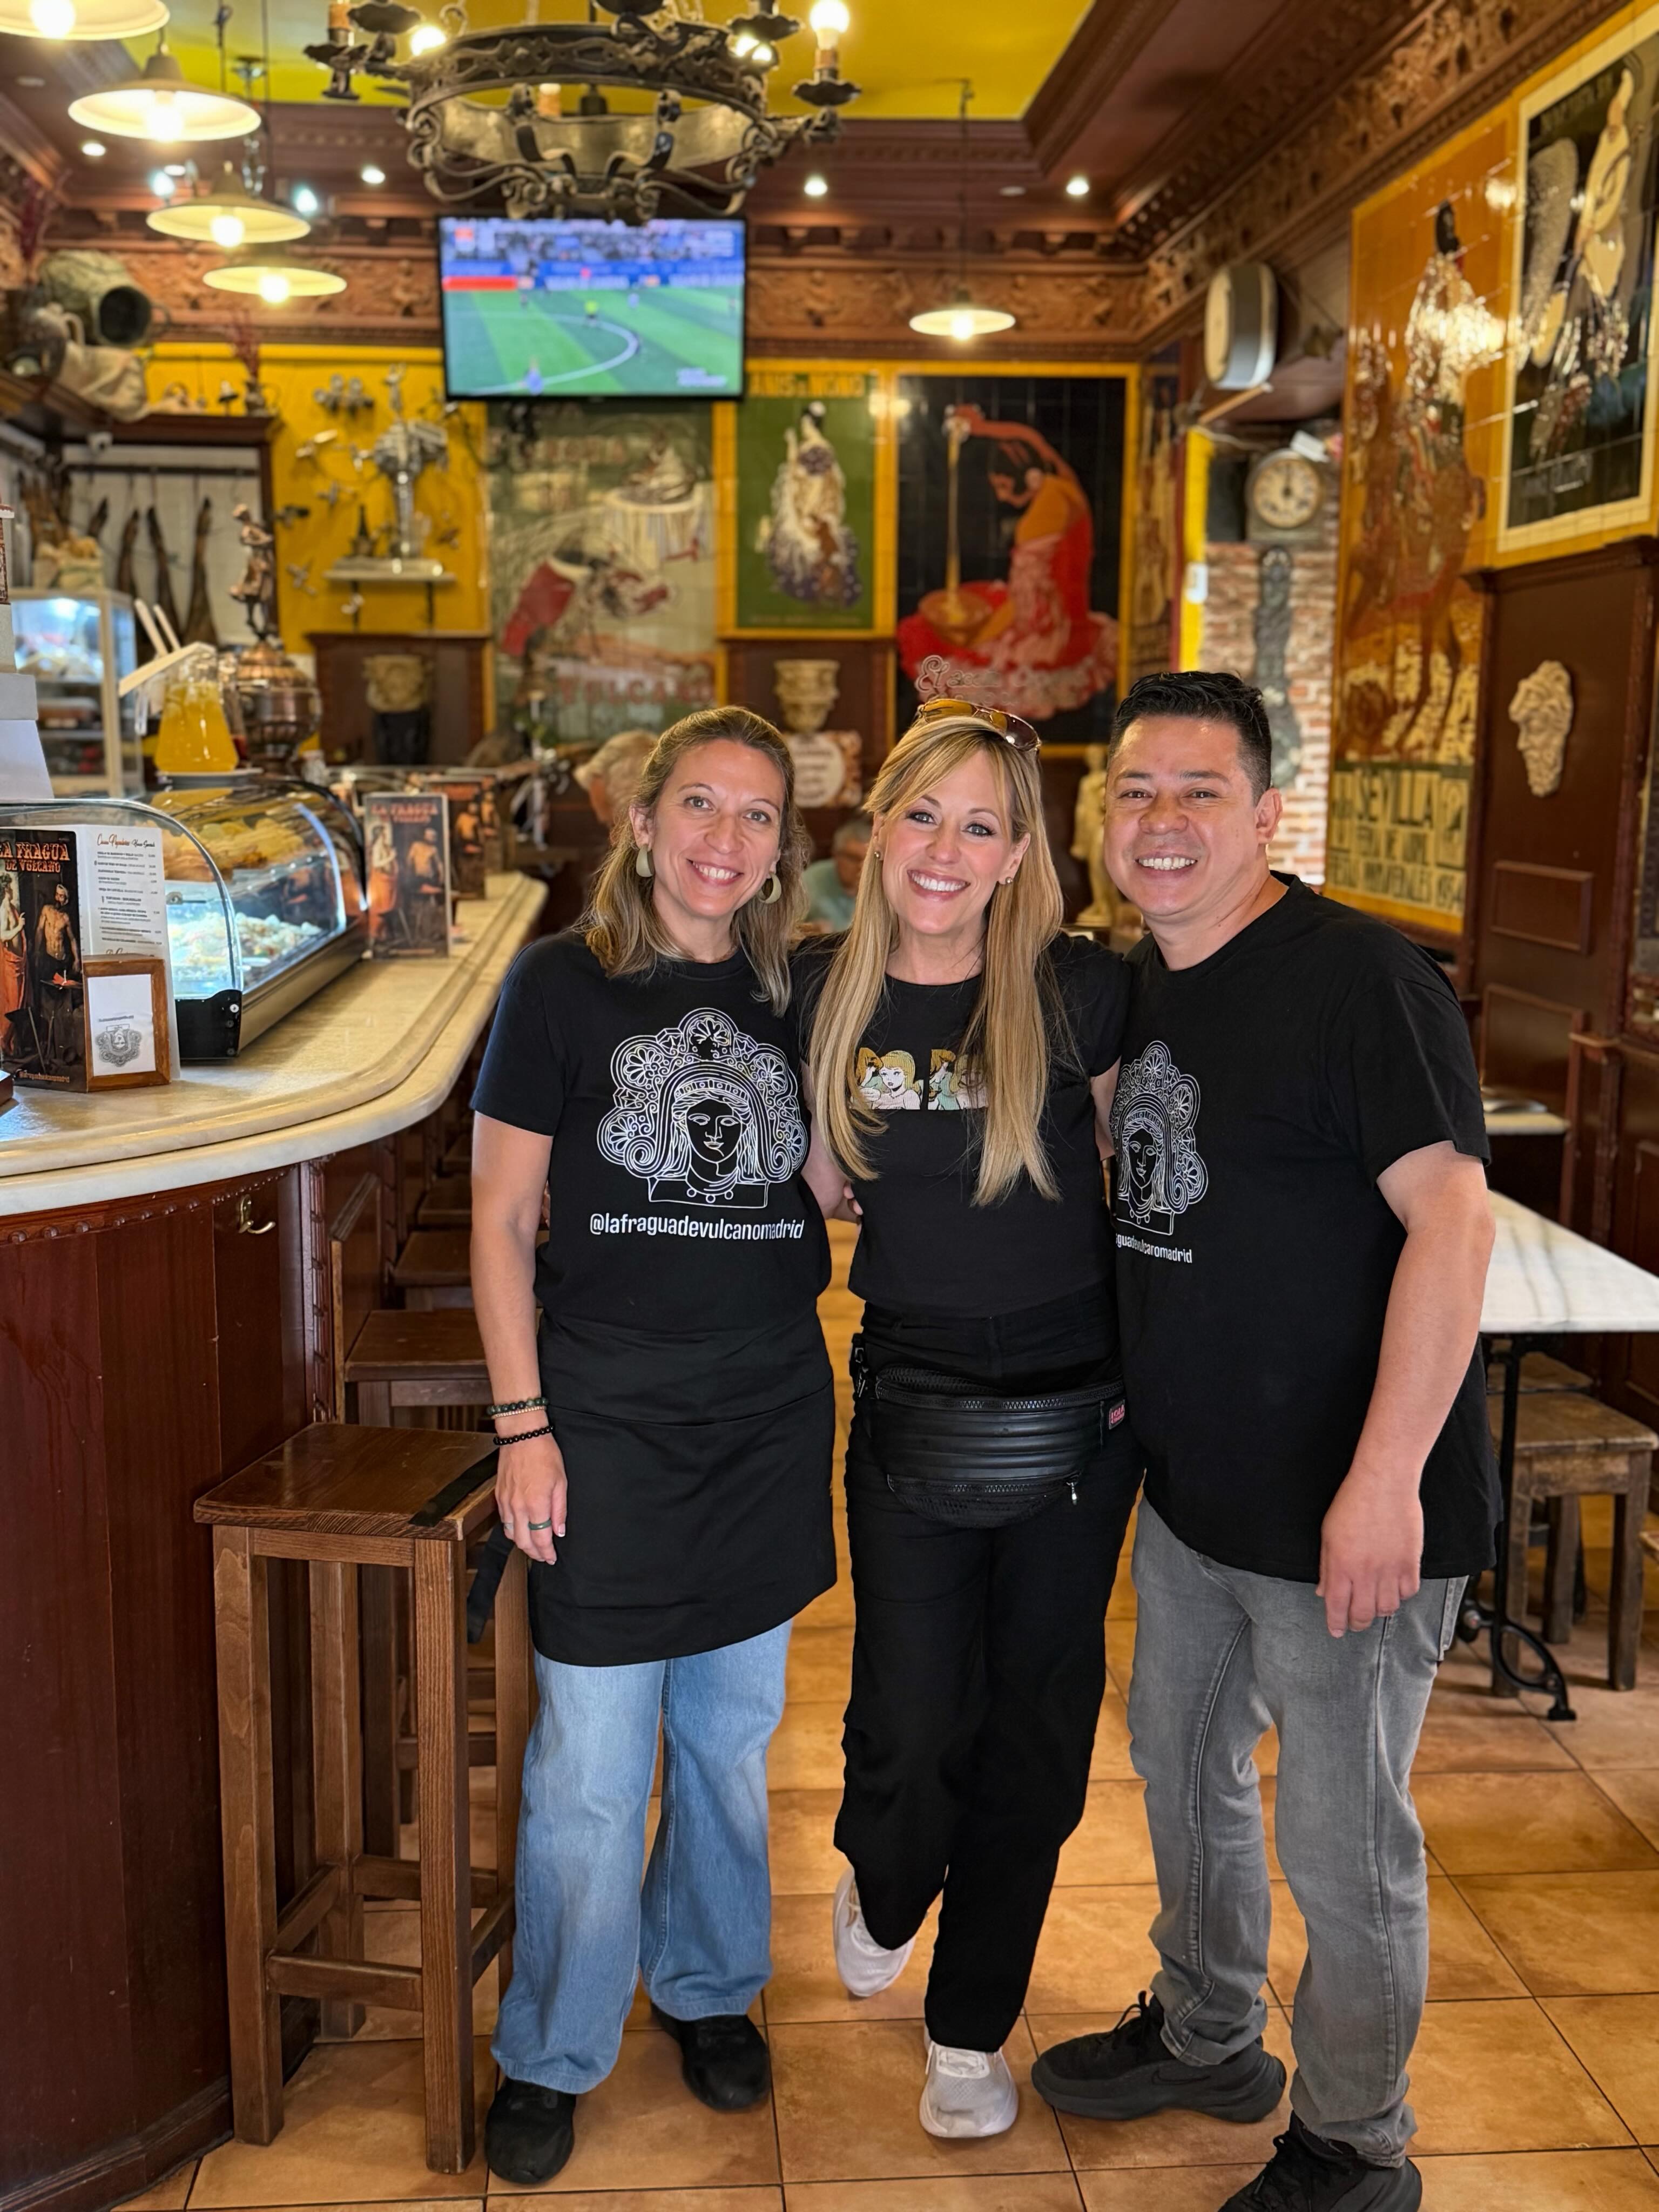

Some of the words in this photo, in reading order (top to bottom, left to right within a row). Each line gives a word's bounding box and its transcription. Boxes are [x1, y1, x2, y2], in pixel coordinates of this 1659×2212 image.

[0, 841, 14, 858] A
[15, 842, 70, 861] FRAGUA
[18, 859, 61, 873] VULCANO
[590, 1212, 805, 1240] @lafraguadevulcanomadrid
